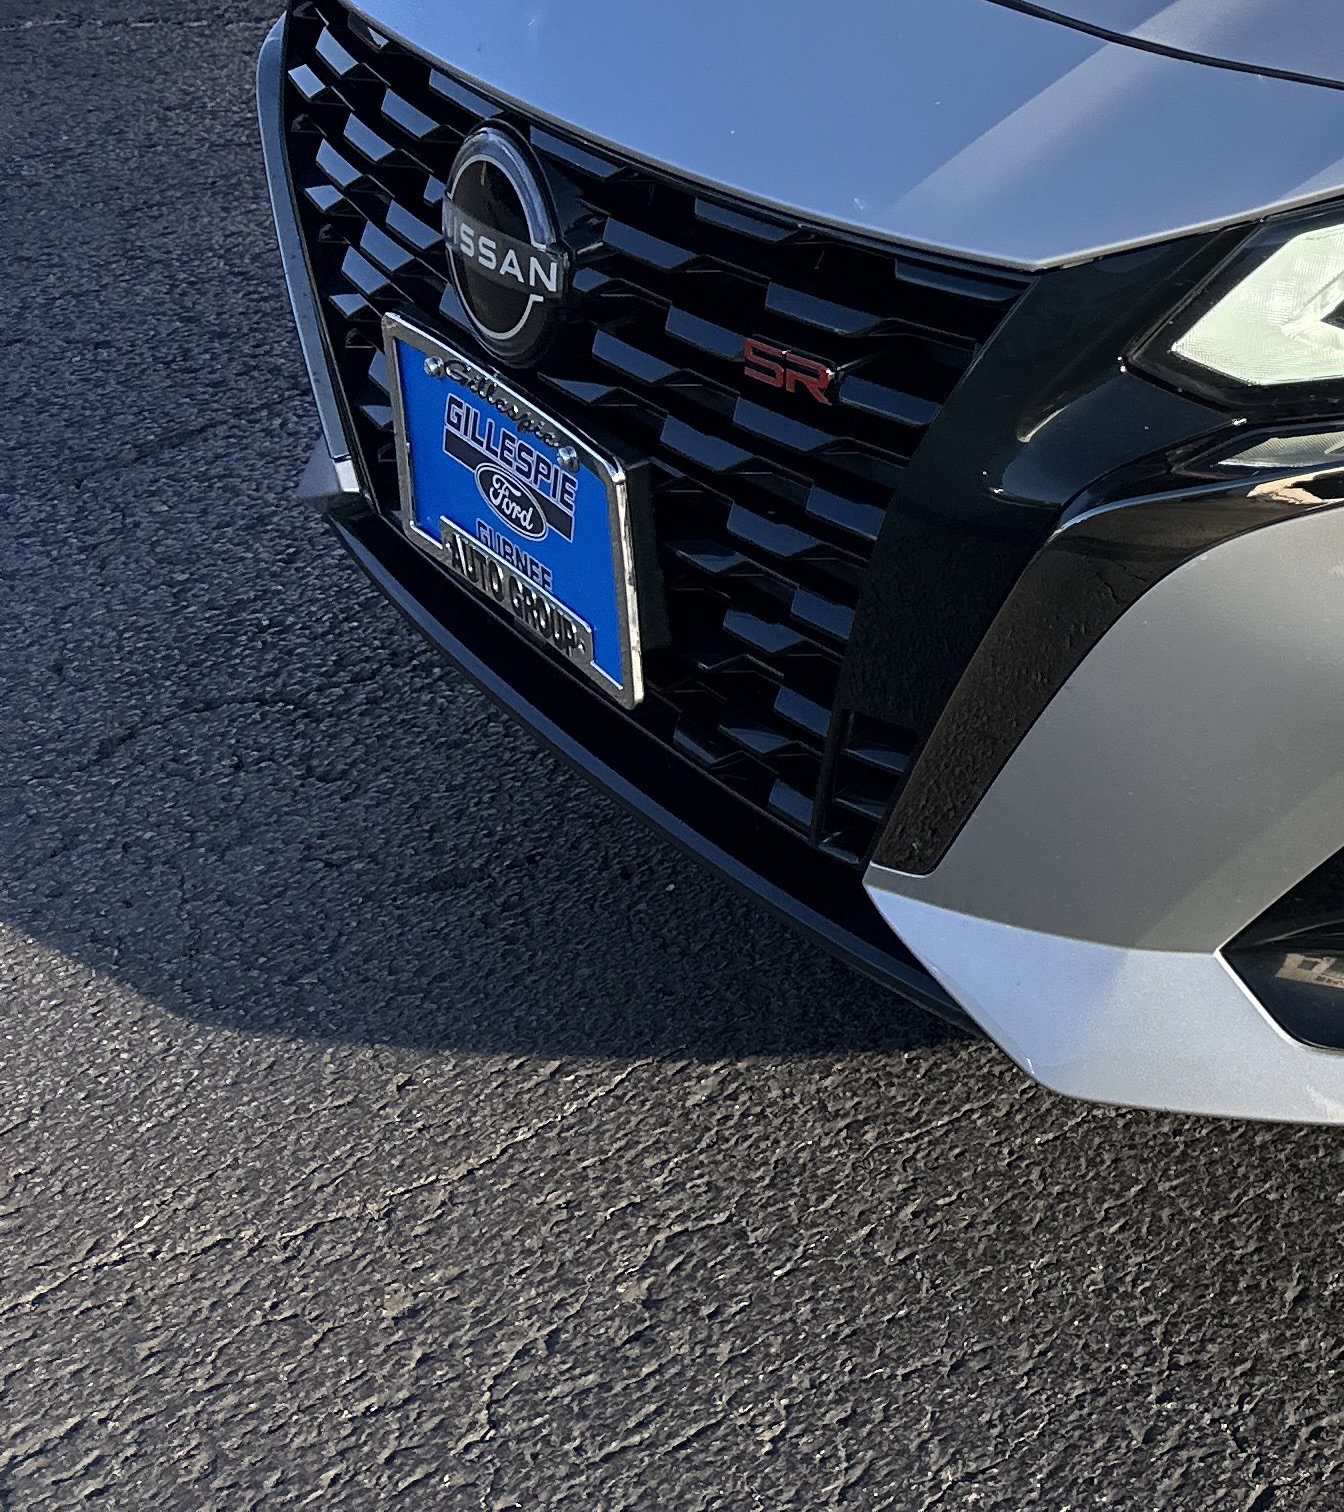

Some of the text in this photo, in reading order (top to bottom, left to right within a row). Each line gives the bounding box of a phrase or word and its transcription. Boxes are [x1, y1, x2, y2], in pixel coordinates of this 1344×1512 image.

[446, 205, 558, 293] NISSAN
[744, 338, 833, 406] SR
[445, 392, 579, 514] GILLESPIE
[489, 472, 534, 530] Ford
[450, 532, 578, 657] AUTO GROUP
